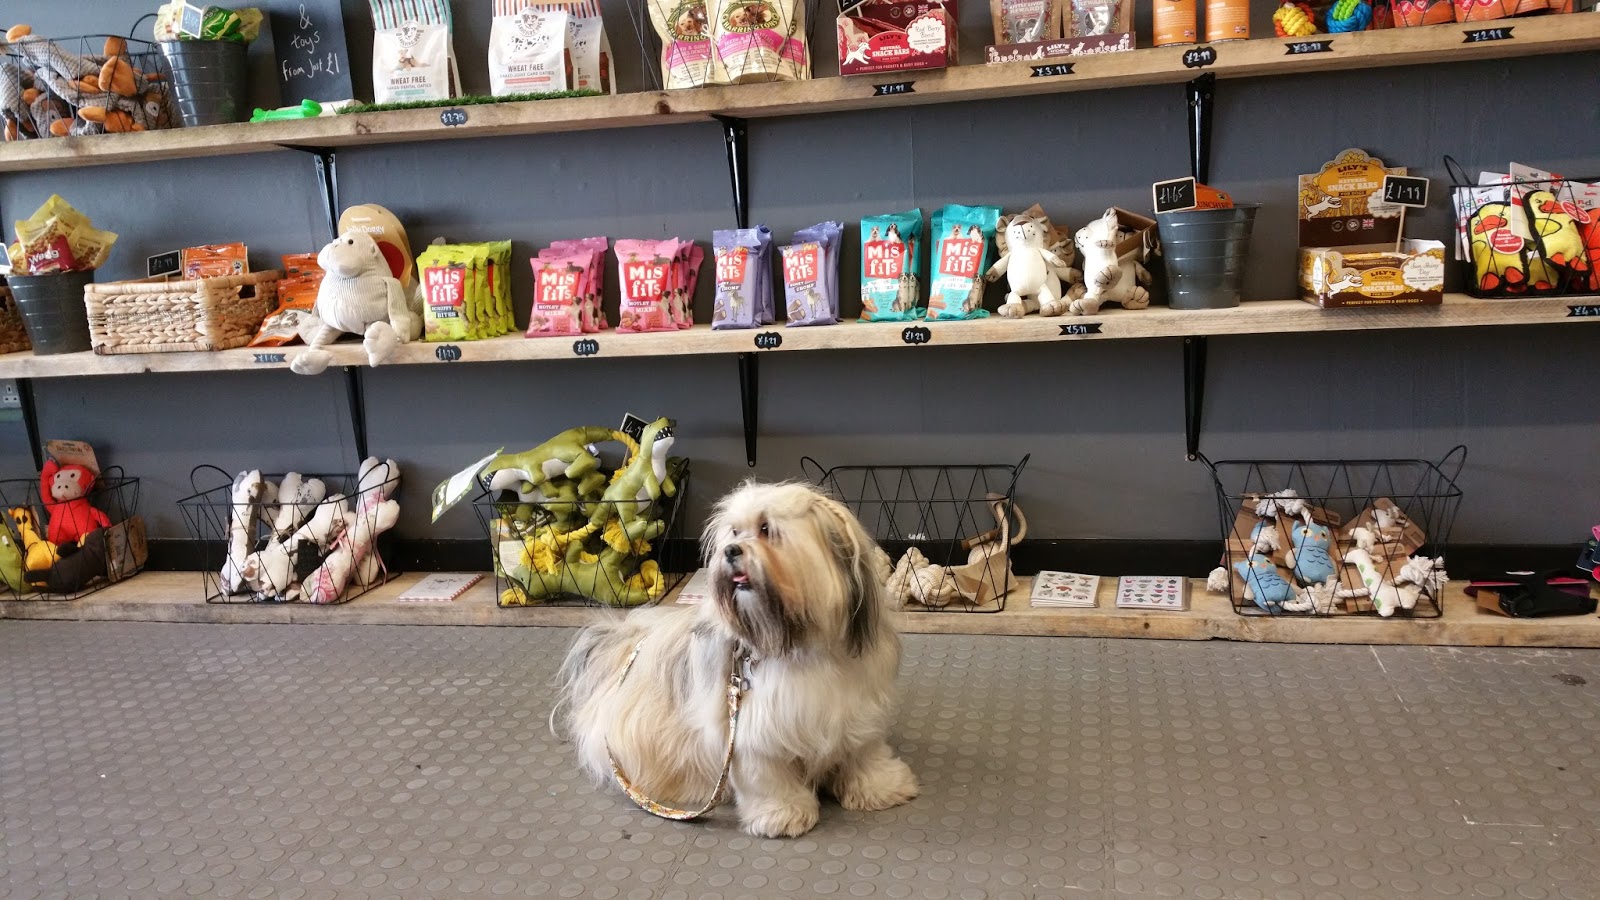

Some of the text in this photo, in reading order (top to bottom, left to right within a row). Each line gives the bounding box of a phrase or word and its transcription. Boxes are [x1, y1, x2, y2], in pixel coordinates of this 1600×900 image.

[299, 4, 313, 29] &
[290, 31, 320, 54] toys
[282, 60, 305, 81] from
[326, 52, 340, 74] £1
[508, 64, 527, 72] WHEAT
[1338, 164, 1368, 173] LILY'S
[1160, 185, 1187, 203] £1.65
[1328, 184, 1355, 192] SNACK
[1386, 182, 1420, 200] £1.99
